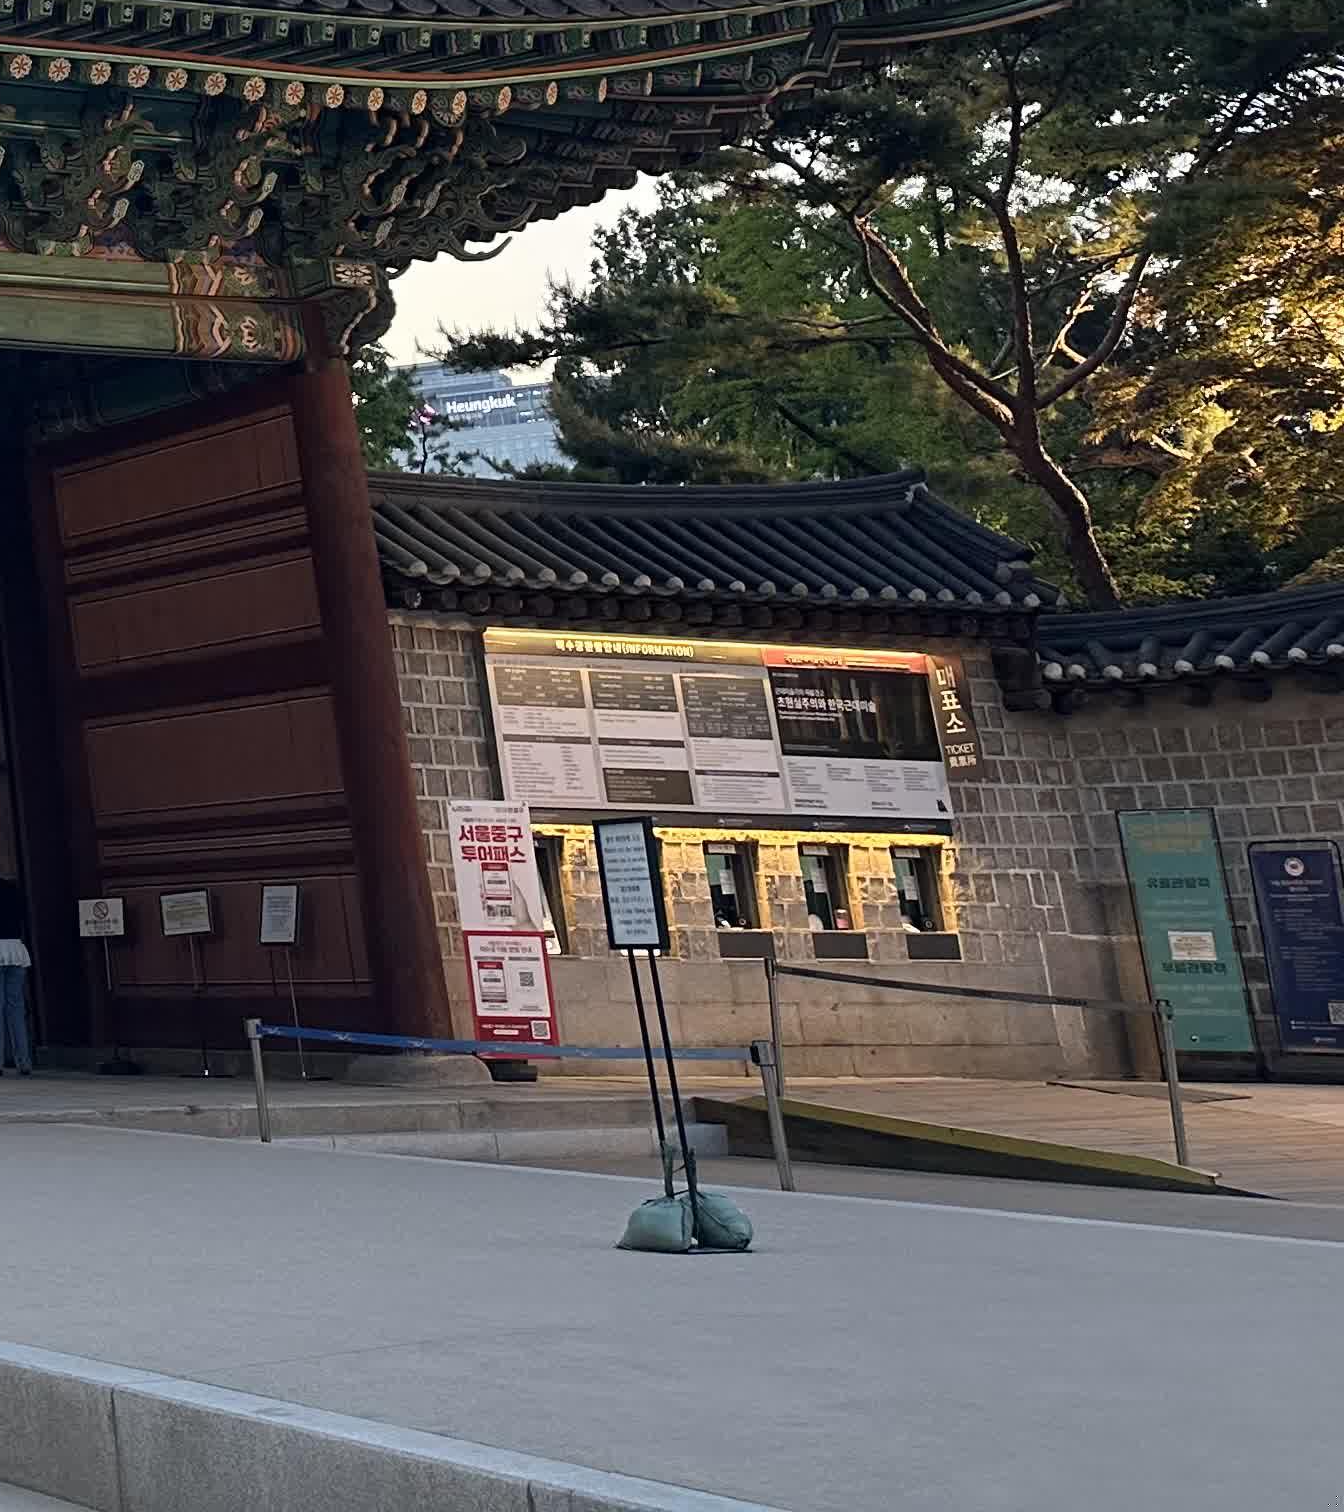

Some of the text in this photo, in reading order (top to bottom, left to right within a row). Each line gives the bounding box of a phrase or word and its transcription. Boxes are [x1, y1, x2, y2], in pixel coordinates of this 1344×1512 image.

[446, 394, 516, 414] Heungkuk
[936, 665, 966, 734] 매표소
[945, 743, 975, 756] TICKET
[459, 825, 523, 843] 서울중구
[461, 845, 527, 863] 투어패스
